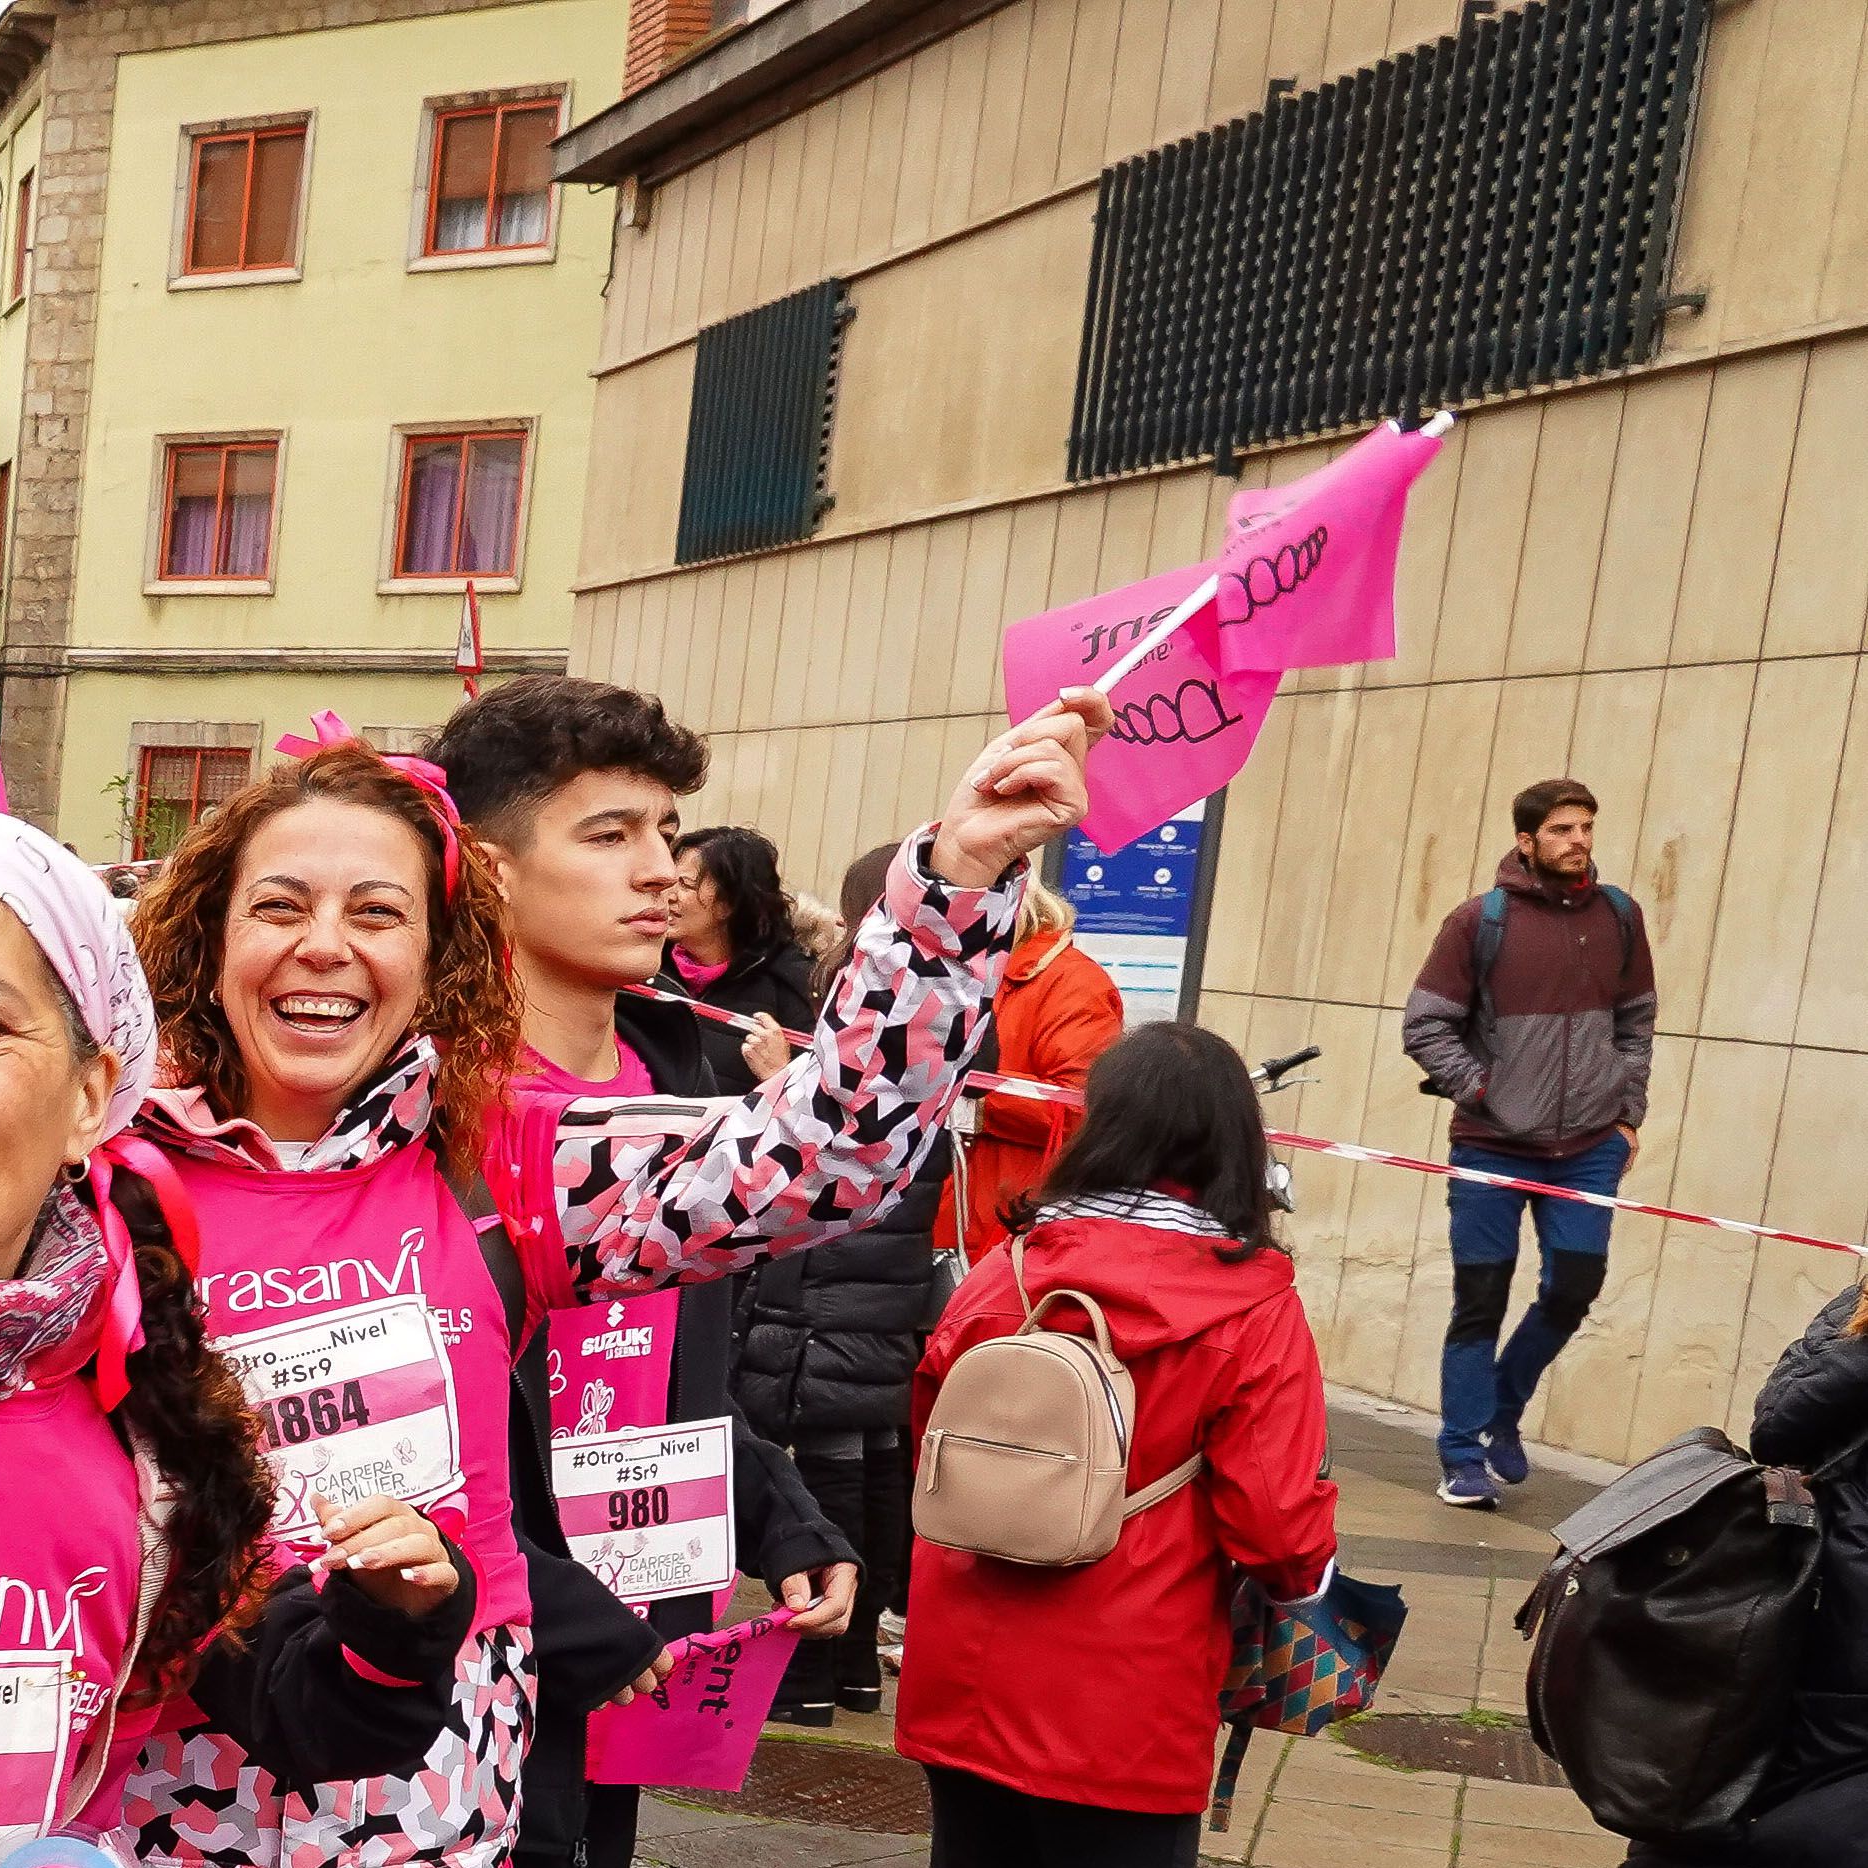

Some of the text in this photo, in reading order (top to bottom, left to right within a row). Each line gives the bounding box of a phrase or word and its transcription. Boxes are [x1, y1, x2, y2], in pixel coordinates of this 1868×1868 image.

[581, 1326, 654, 1357] SUZUKI
[271, 1356, 333, 1389] #Sr9
[262, 1380, 371, 1447] 1864
[315, 1459, 393, 1493] CARRERA
[340, 1472, 406, 1507] MUJER
[616, 1463, 659, 1483] #Sr9
[608, 1485, 669, 1531] 980
[646, 1564, 692, 1584] MUJER
